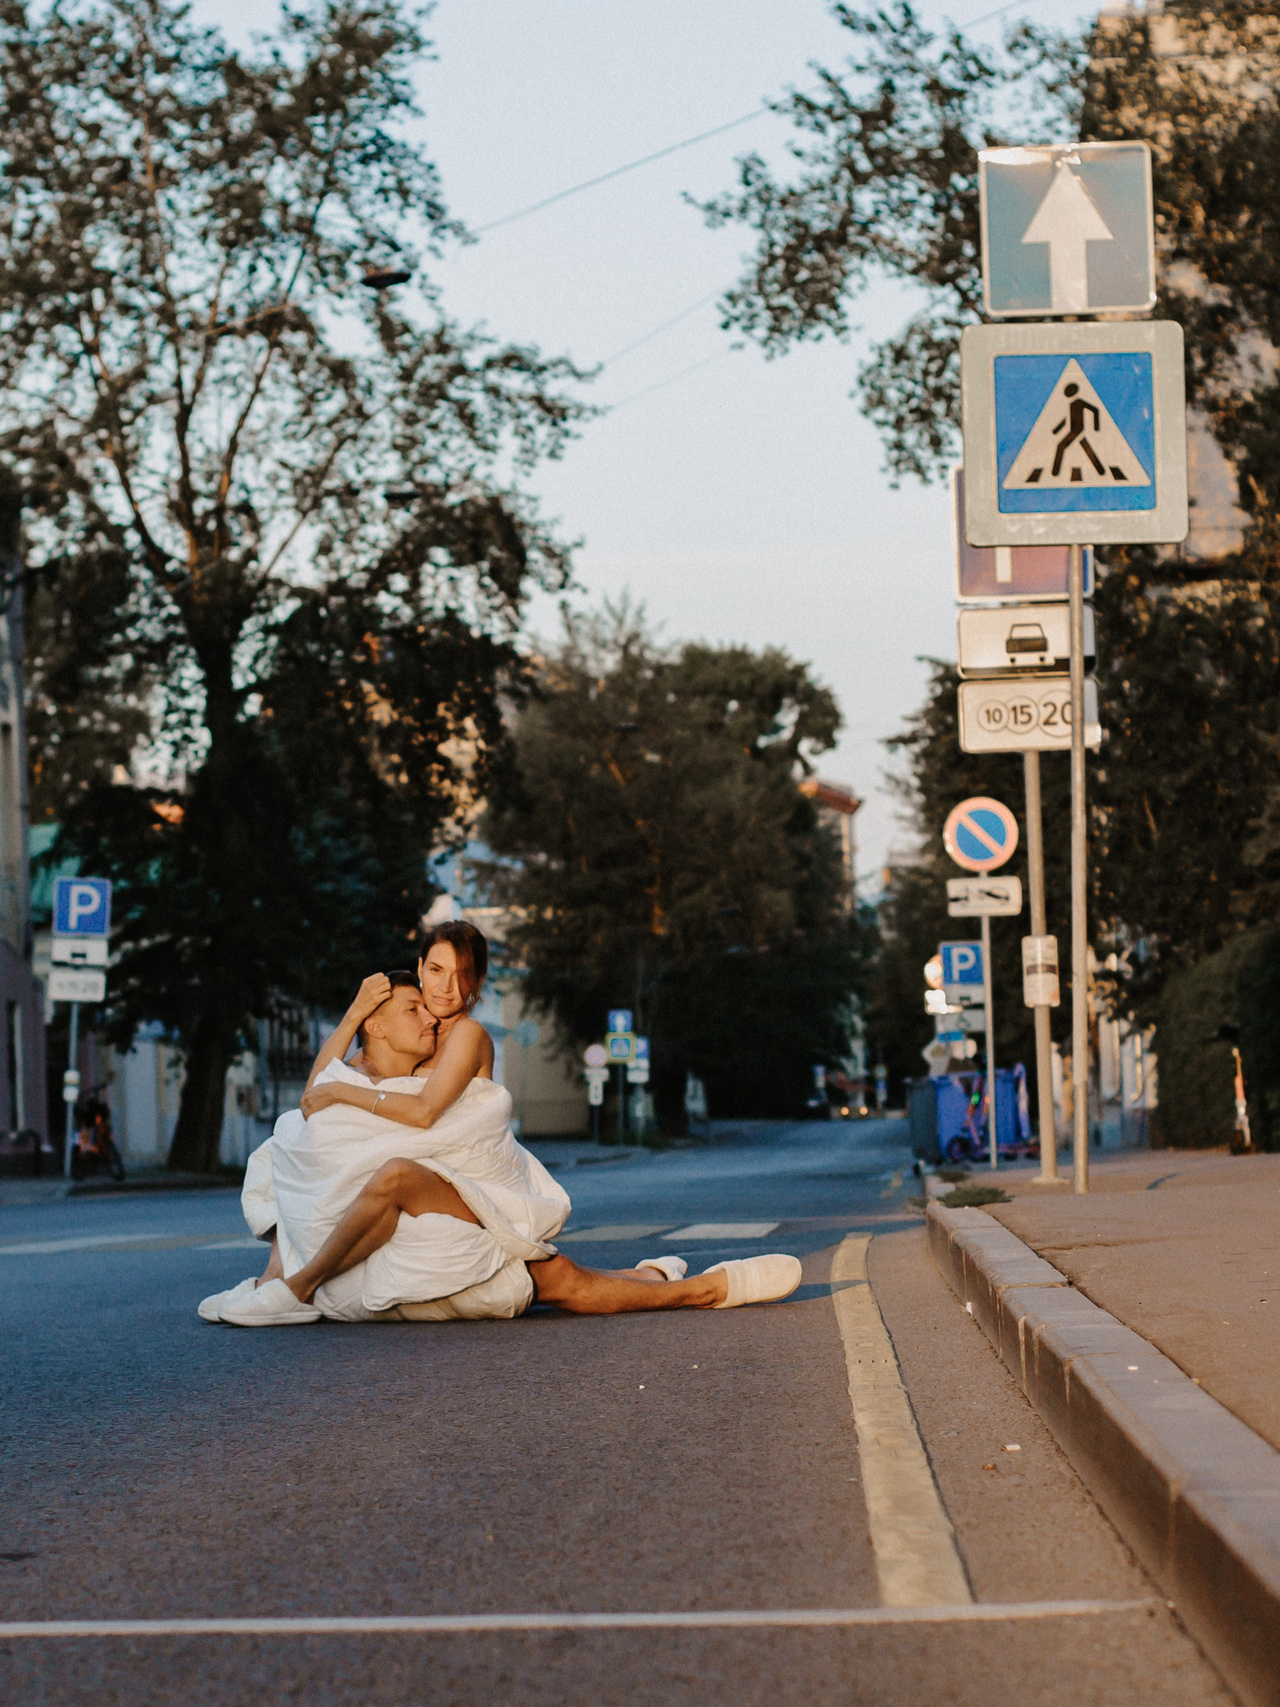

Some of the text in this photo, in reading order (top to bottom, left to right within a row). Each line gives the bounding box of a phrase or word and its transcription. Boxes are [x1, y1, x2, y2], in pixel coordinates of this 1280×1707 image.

[985, 708, 1003, 723] 10
[1011, 704, 1032, 725] 15
[67, 884, 101, 930] P
[950, 947, 977, 981] P
